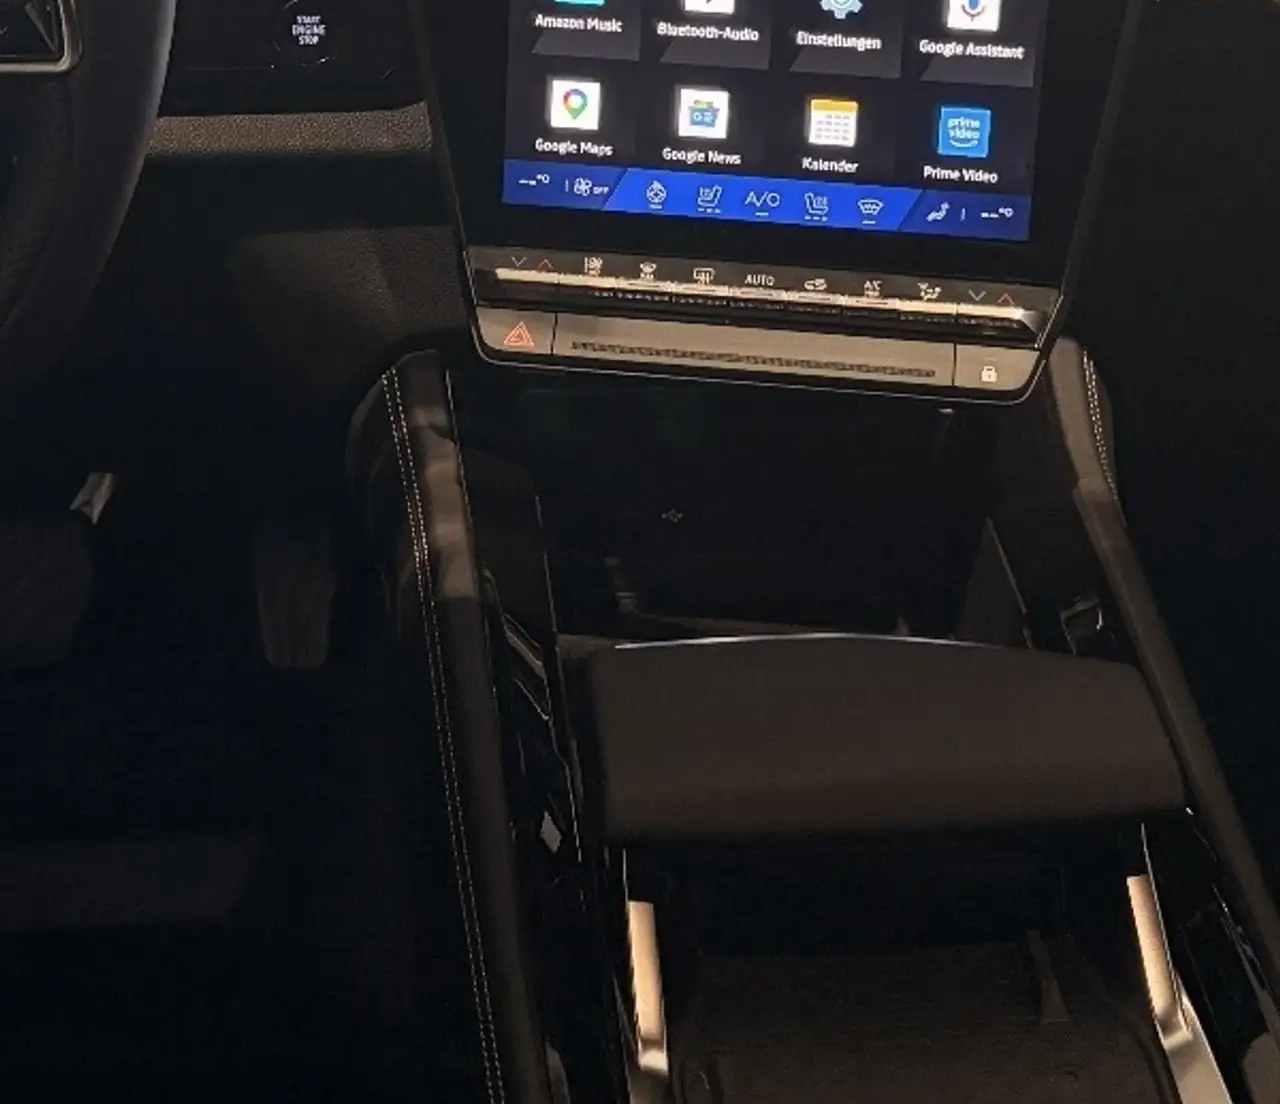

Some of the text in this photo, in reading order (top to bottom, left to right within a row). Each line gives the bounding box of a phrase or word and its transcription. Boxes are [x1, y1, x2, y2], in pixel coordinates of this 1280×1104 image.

[535, 14, 622, 33] Amazon Music
[656, 21, 760, 42] Bluetooth-Audio
[796, 30, 882, 52] Einstellungen
[919, 39, 1025, 60] Google Assistant
[535, 137, 614, 157] Google Maps
[662, 147, 742, 165] Google News
[801, 156, 859, 174] Kalender
[923, 165, 999, 184] Prime Video
[744, 274, 776, 286] AUTO
